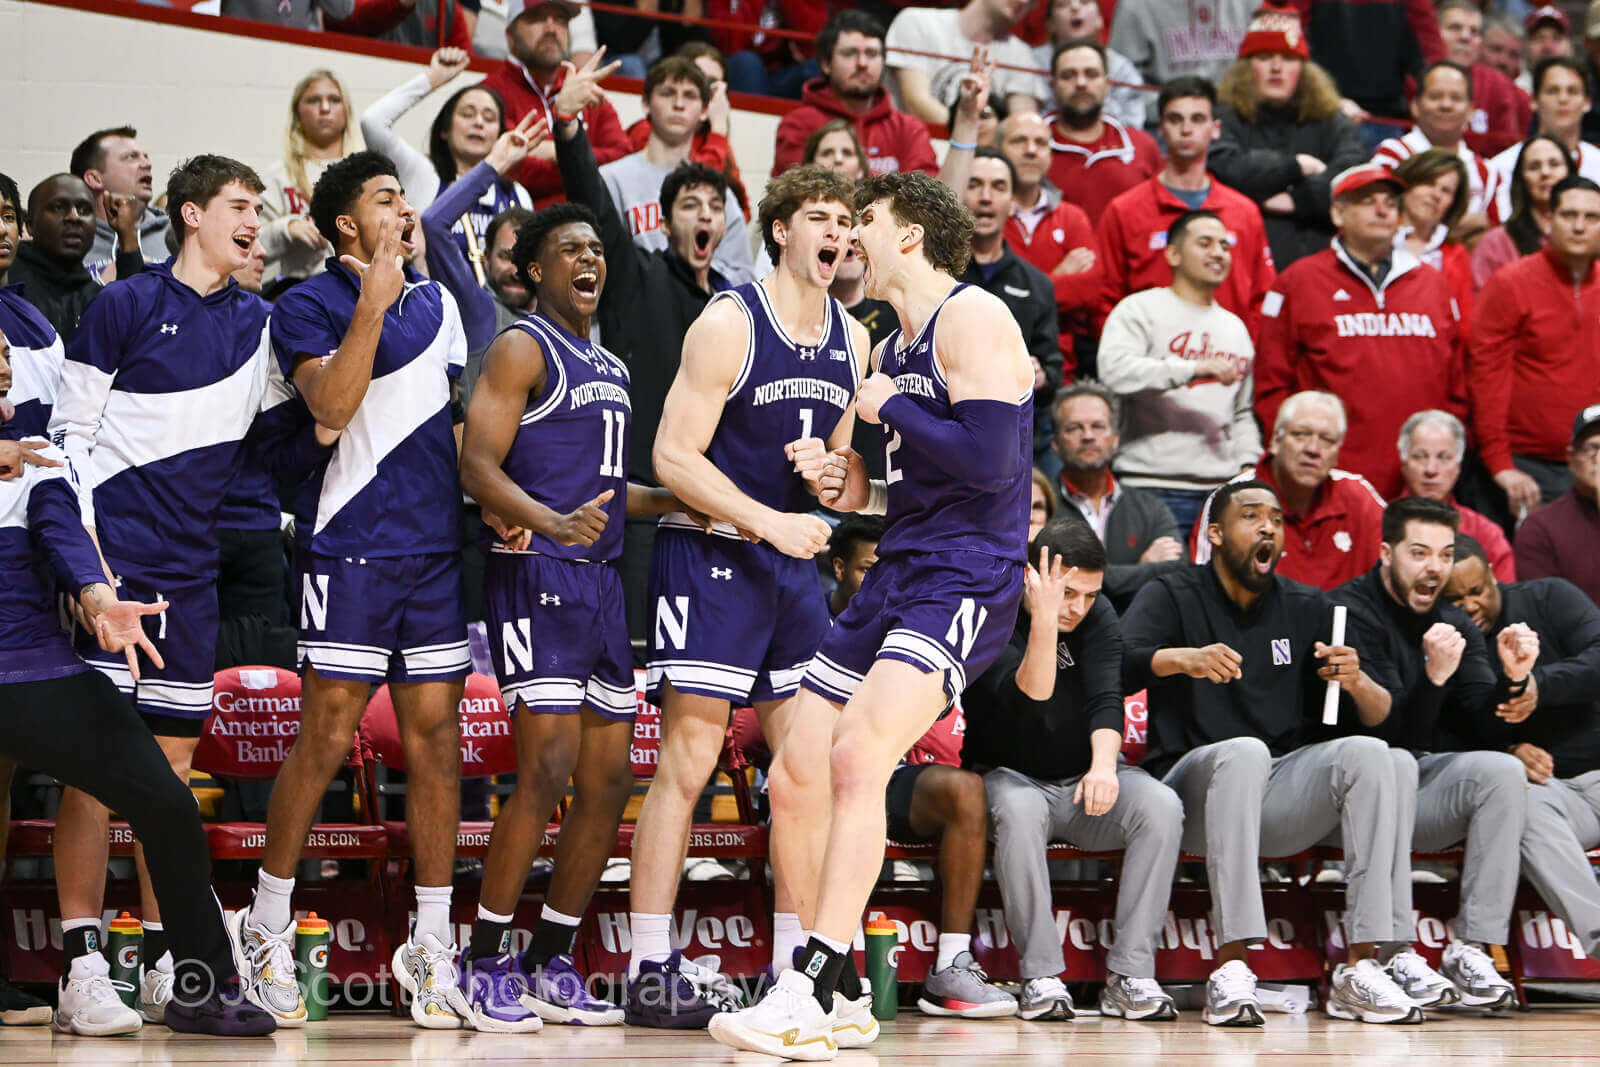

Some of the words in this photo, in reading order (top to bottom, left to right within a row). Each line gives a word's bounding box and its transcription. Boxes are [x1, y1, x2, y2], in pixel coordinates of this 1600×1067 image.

[1334, 312, 1437, 338] INDIANA
[752, 378, 850, 410] NORTHWESTERN
[600, 408, 625, 478] 11
[301, 573, 330, 631] N
[655, 596, 689, 650] N
[945, 598, 988, 661] N
[503, 618, 534, 676] N
[1271, 639, 1292, 666] N
[210, 715, 301, 737] America
[118, 945, 138, 969] G
[309, 944, 328, 968] G
